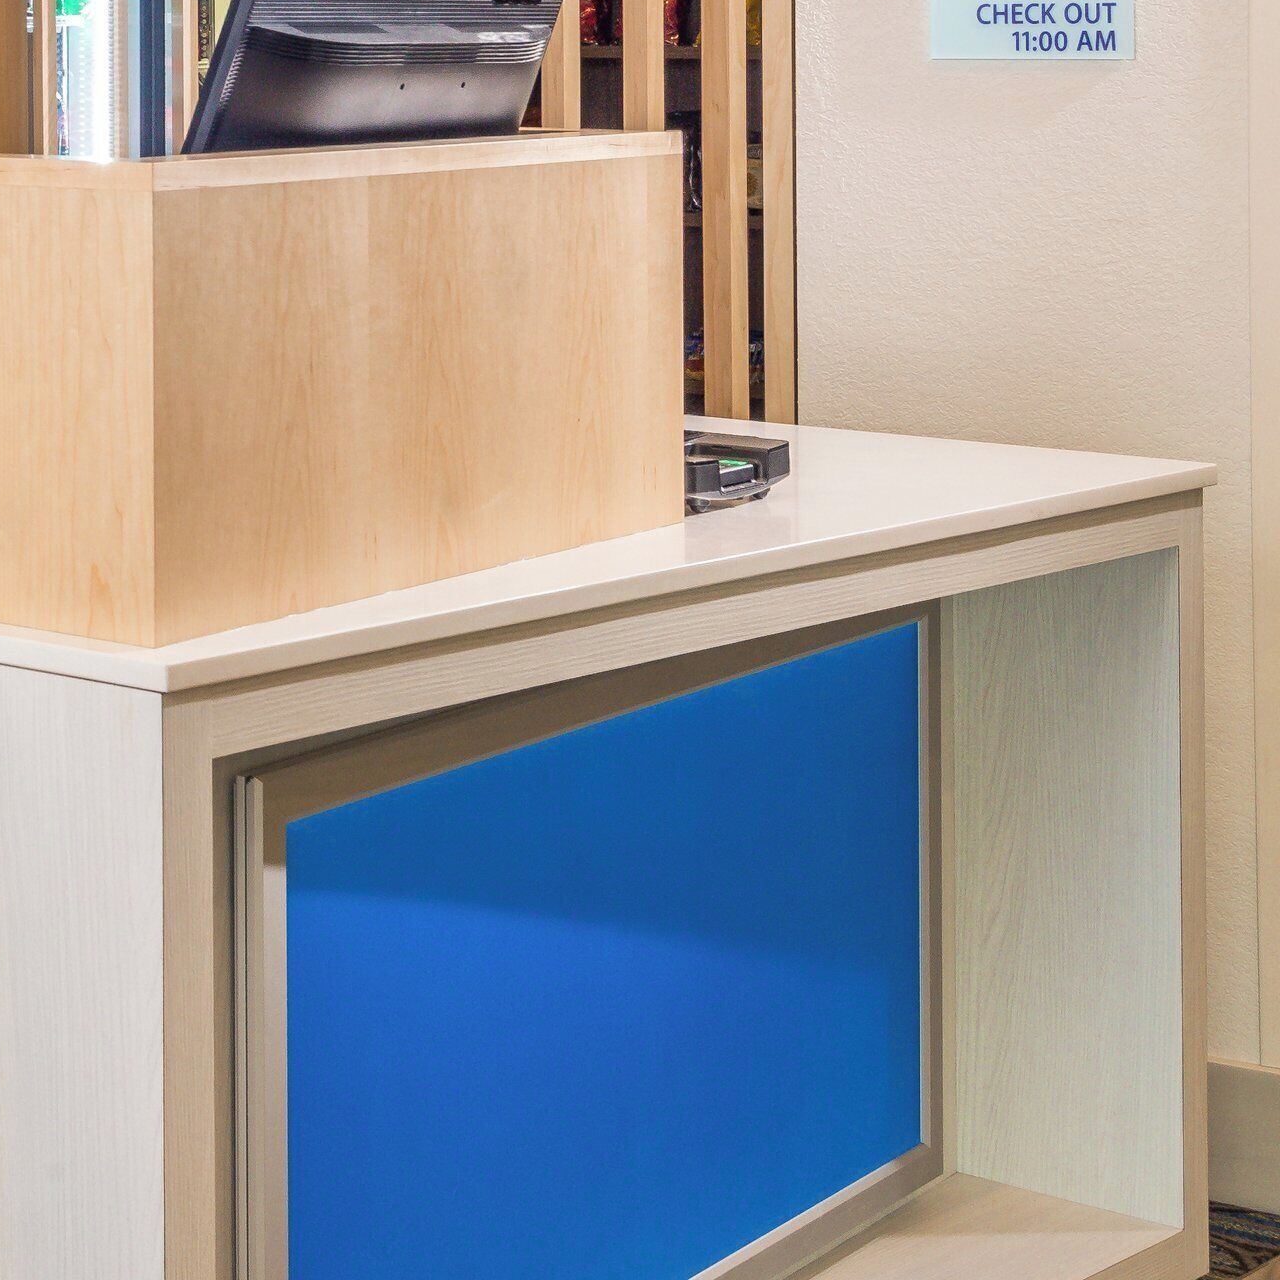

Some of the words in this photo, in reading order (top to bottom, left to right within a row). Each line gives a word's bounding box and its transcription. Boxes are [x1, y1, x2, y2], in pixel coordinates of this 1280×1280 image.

[976, 3, 1056, 25] CHECK
[1063, 2, 1117, 25] OUT
[1011, 31, 1068, 52] 11:00
[1076, 30, 1117, 52] AM
